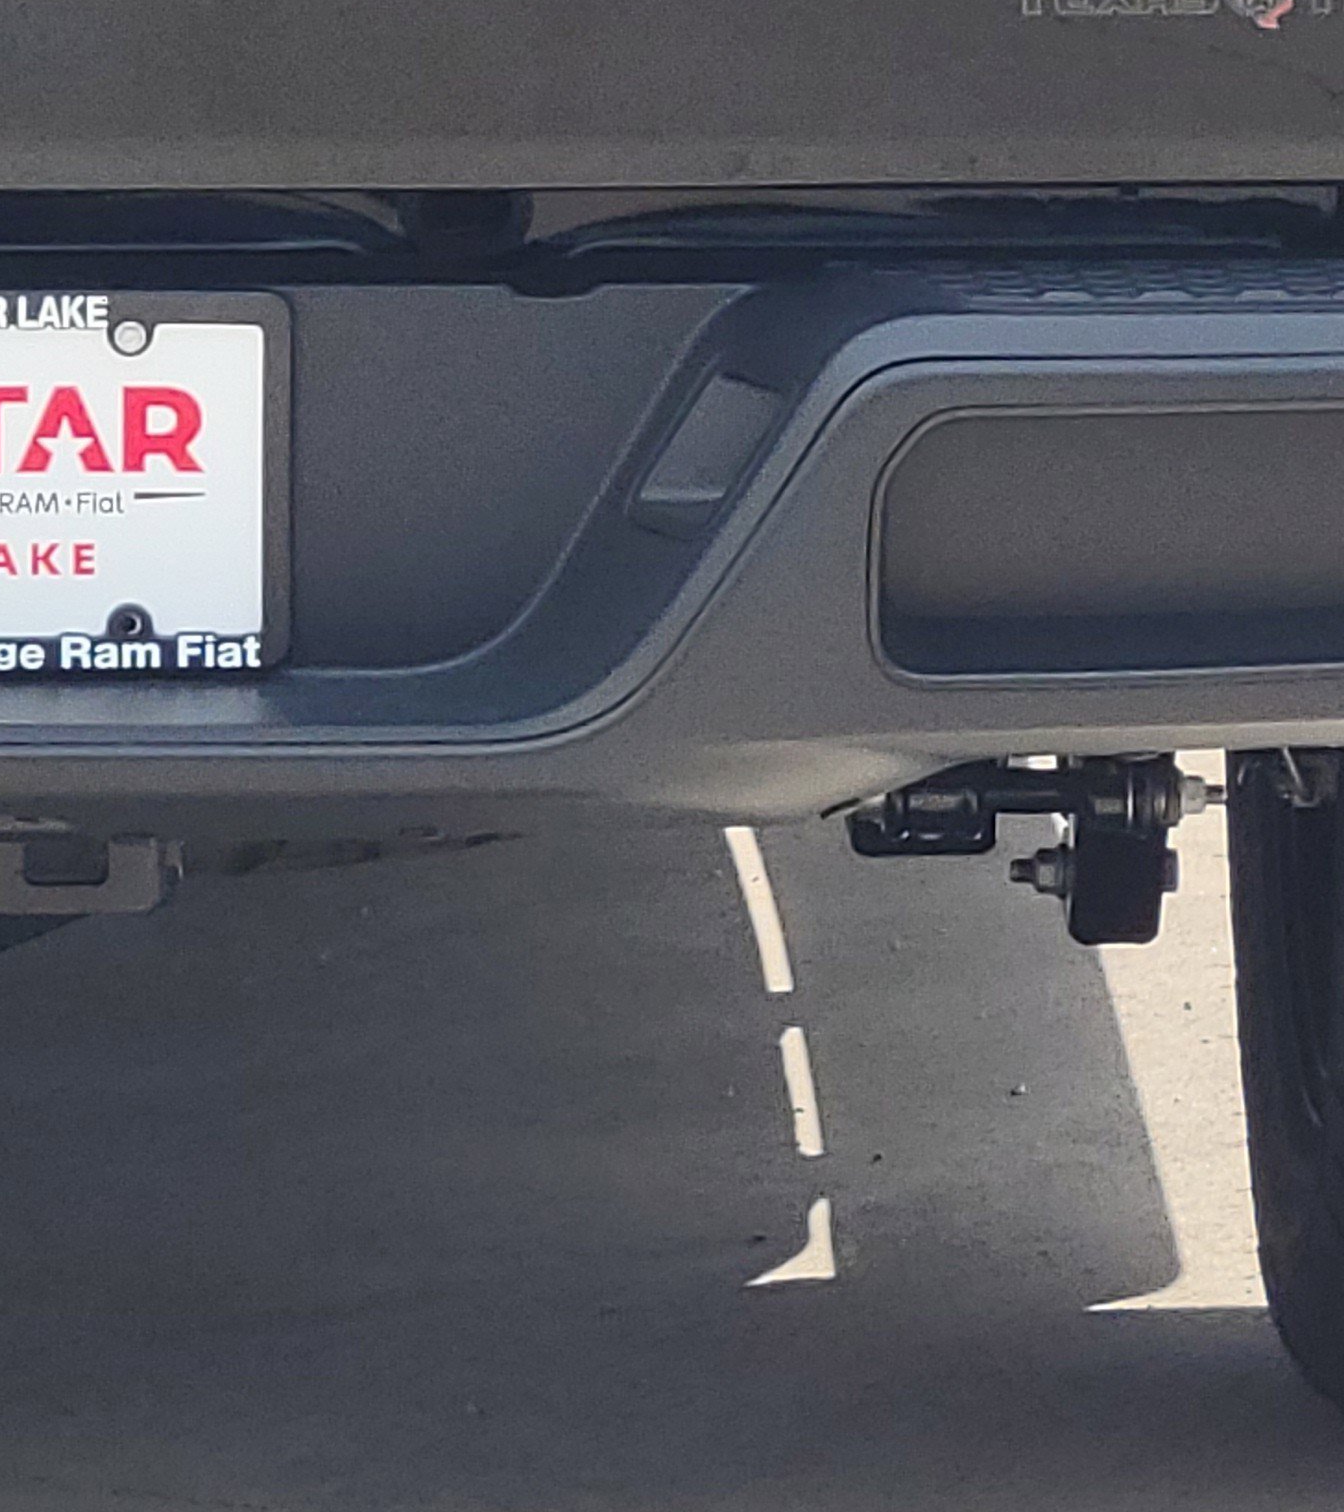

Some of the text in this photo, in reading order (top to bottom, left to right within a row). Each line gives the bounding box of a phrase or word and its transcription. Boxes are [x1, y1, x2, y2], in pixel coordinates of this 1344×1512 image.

[17, 296, 109, 328] LAKE
[60, 636, 162, 670] Ram
[177, 635, 261, 668] Fiat
